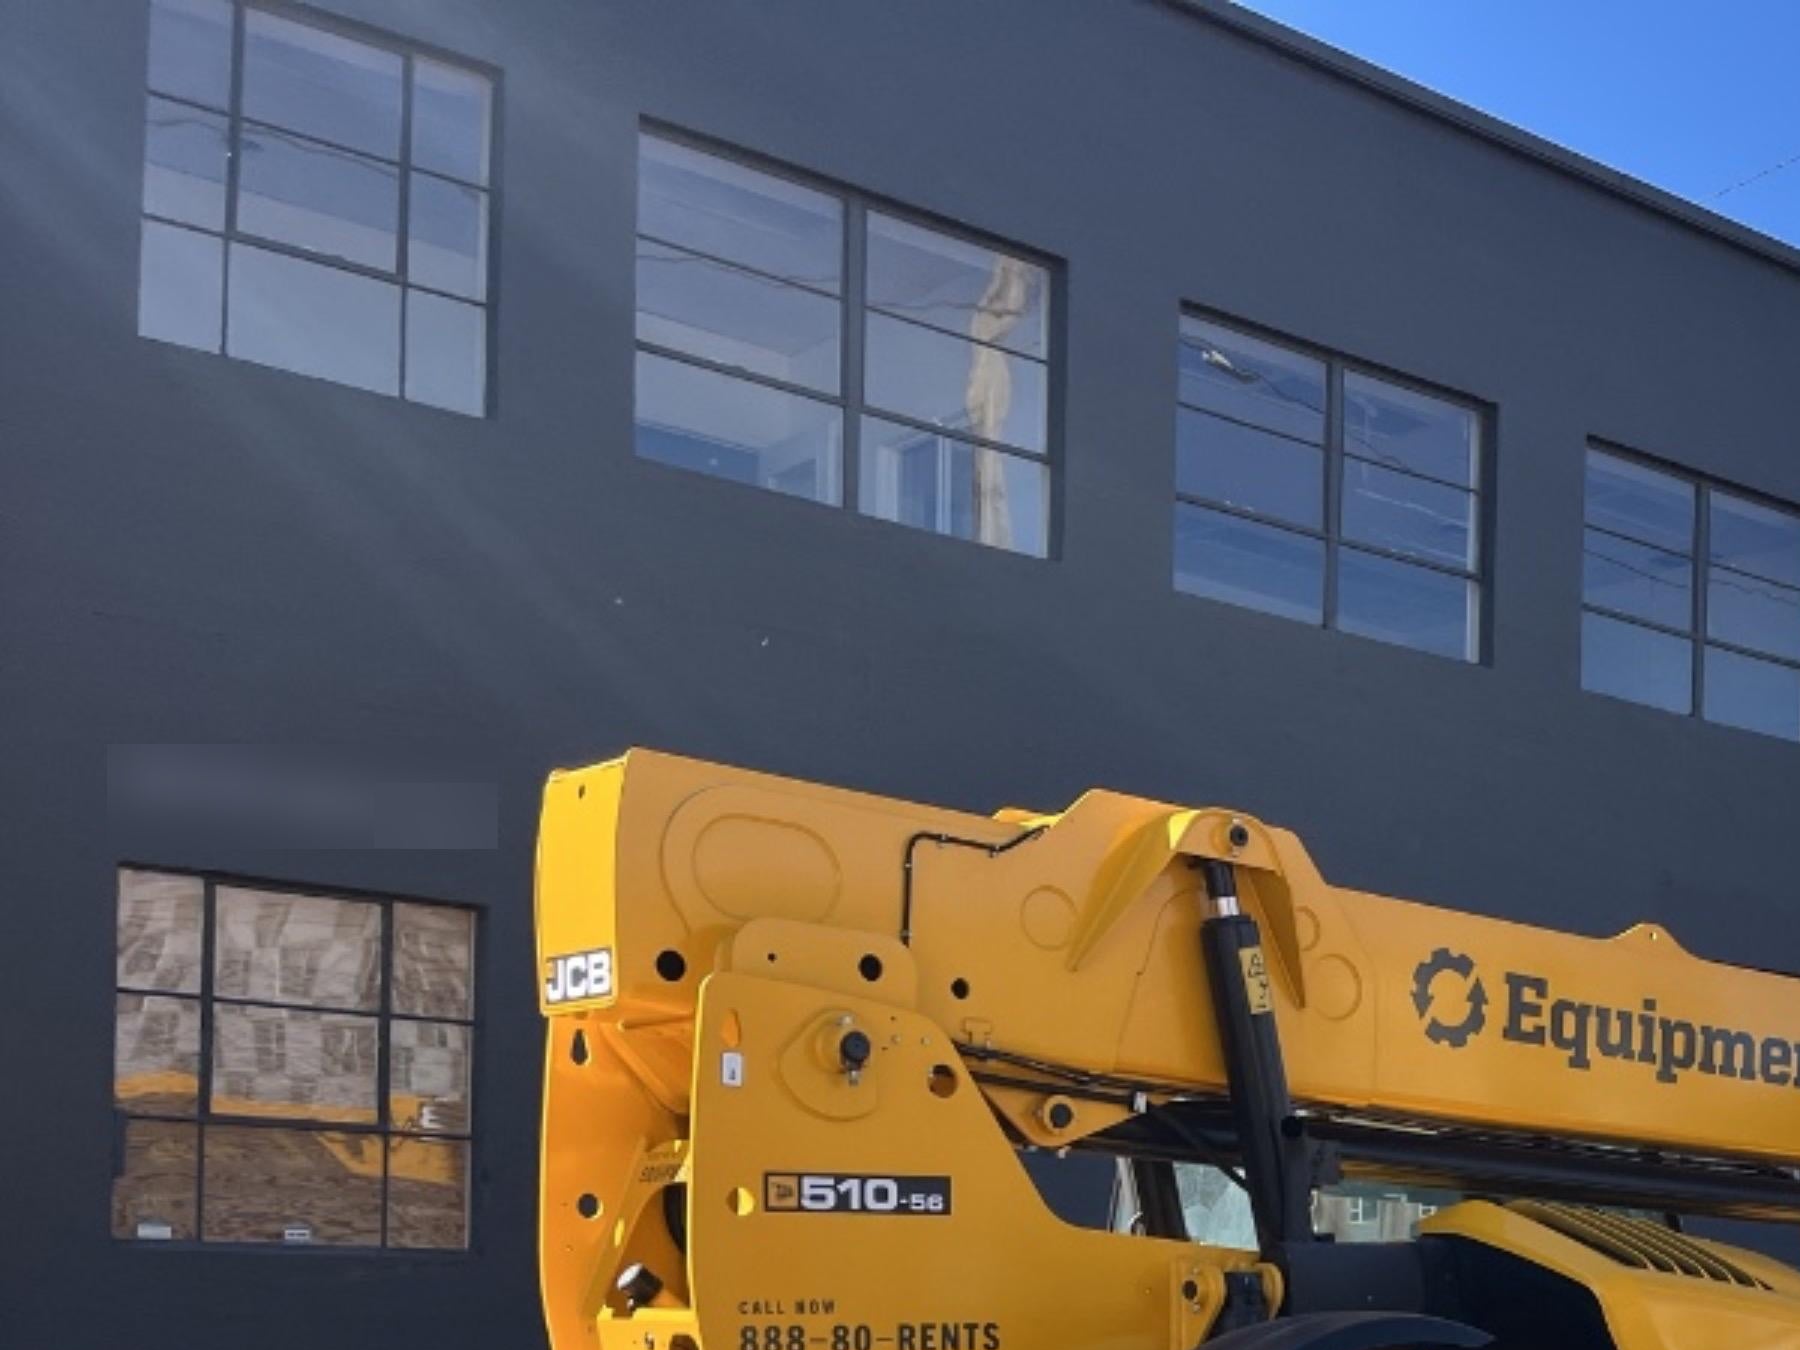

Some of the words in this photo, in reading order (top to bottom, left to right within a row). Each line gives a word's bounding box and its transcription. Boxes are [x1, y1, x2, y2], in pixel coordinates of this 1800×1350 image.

[546, 951, 611, 1003] JCB
[800, 1175, 944, 1212] 510-56
[738, 1301, 785, 1315] CALL
[795, 1300, 836, 1314] NOW
